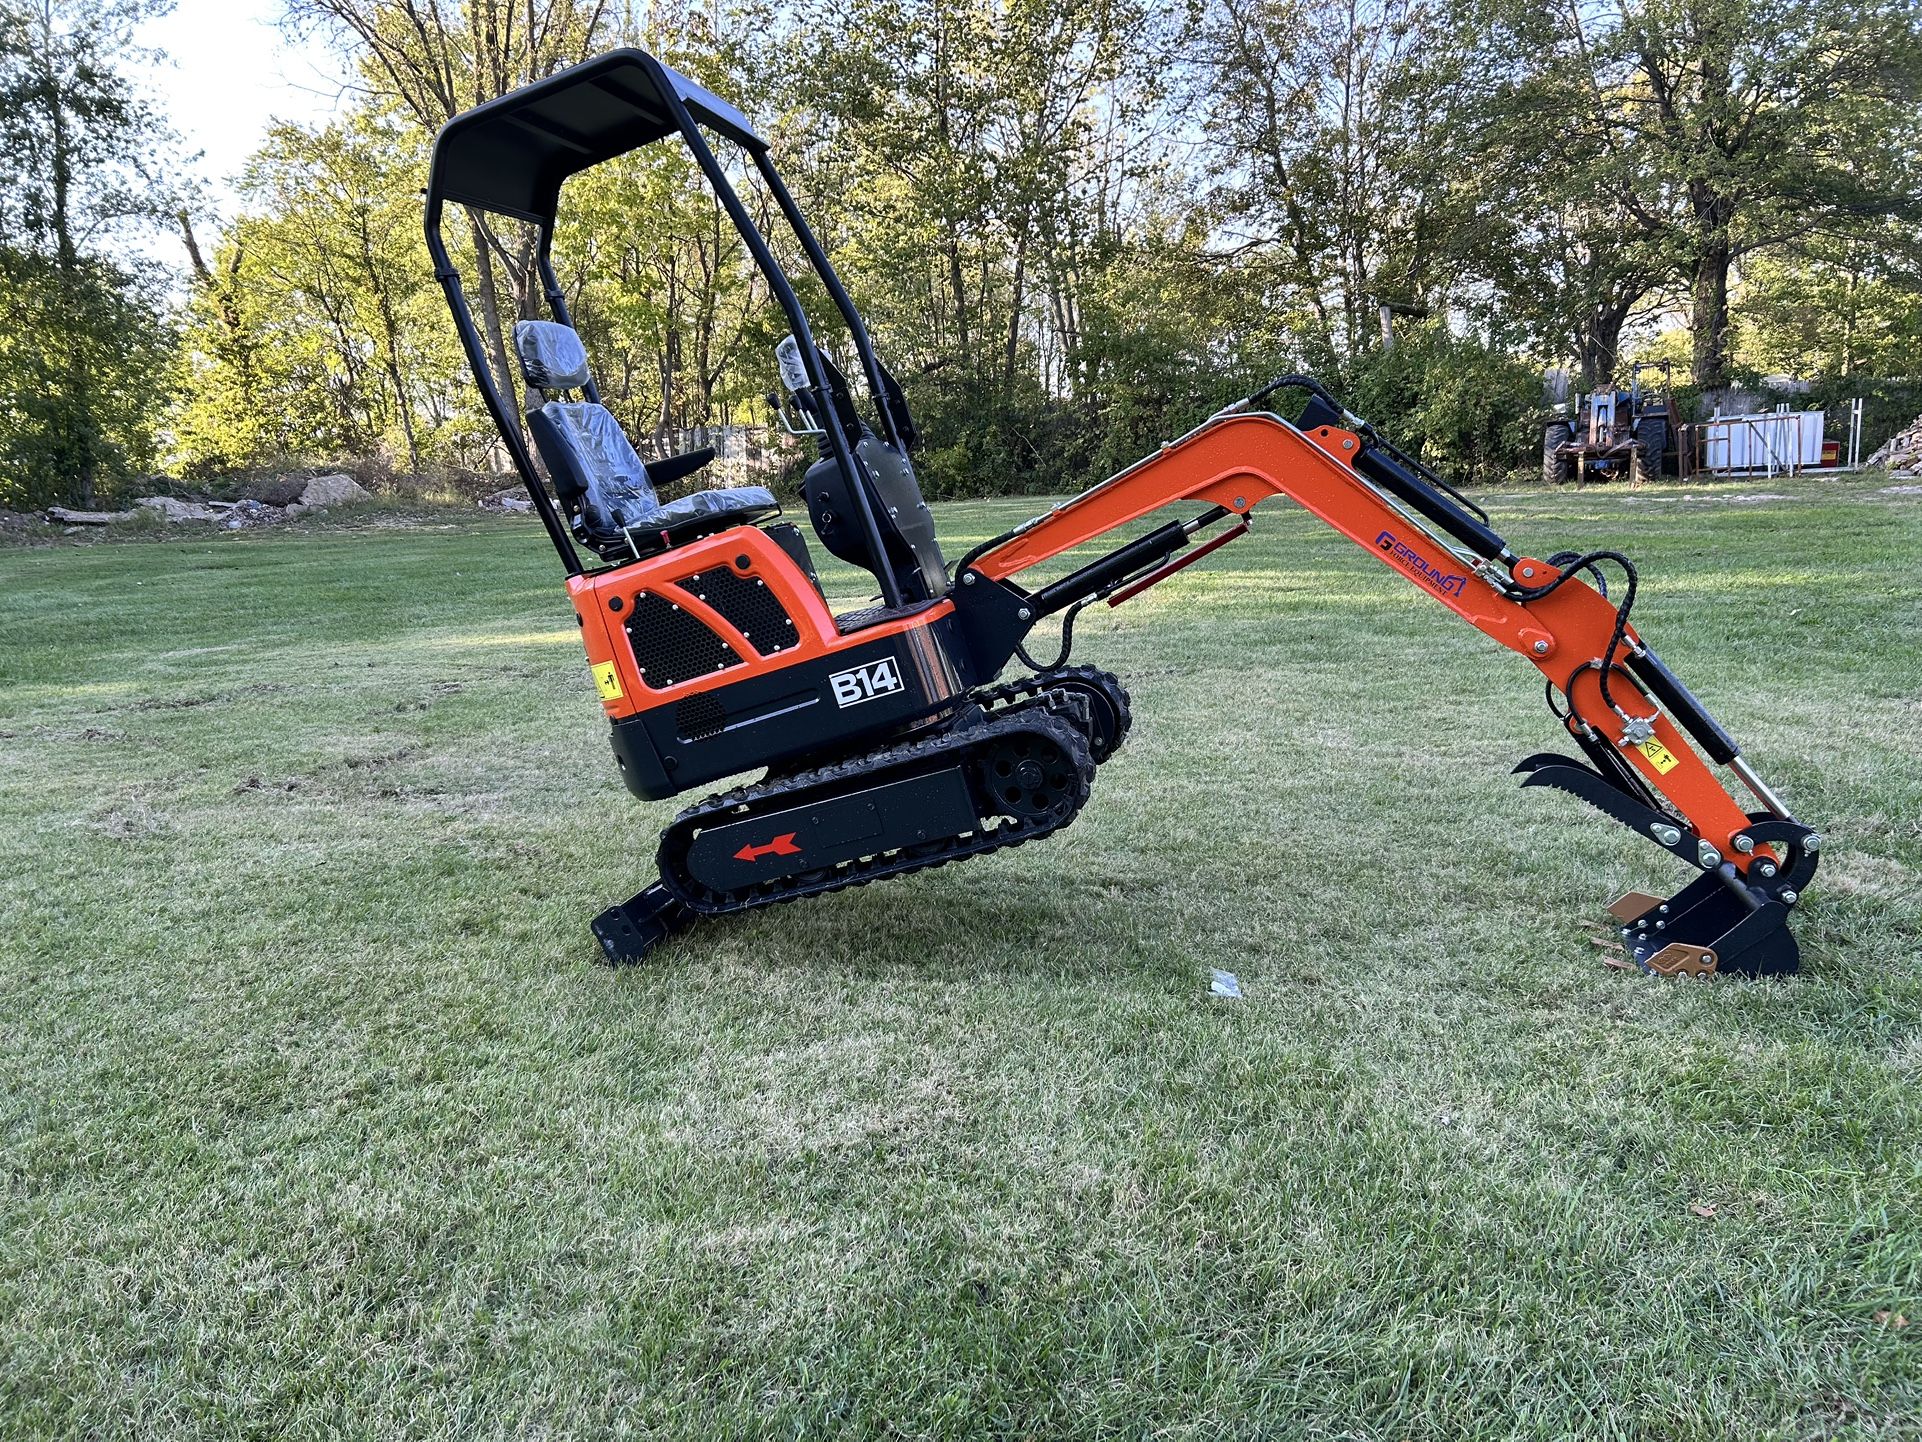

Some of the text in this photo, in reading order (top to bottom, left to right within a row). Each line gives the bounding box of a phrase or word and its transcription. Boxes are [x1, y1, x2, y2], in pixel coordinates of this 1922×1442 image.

[1389, 550, 1448, 596] FORCE EQUIPMENT
[830, 662, 898, 706] B14
